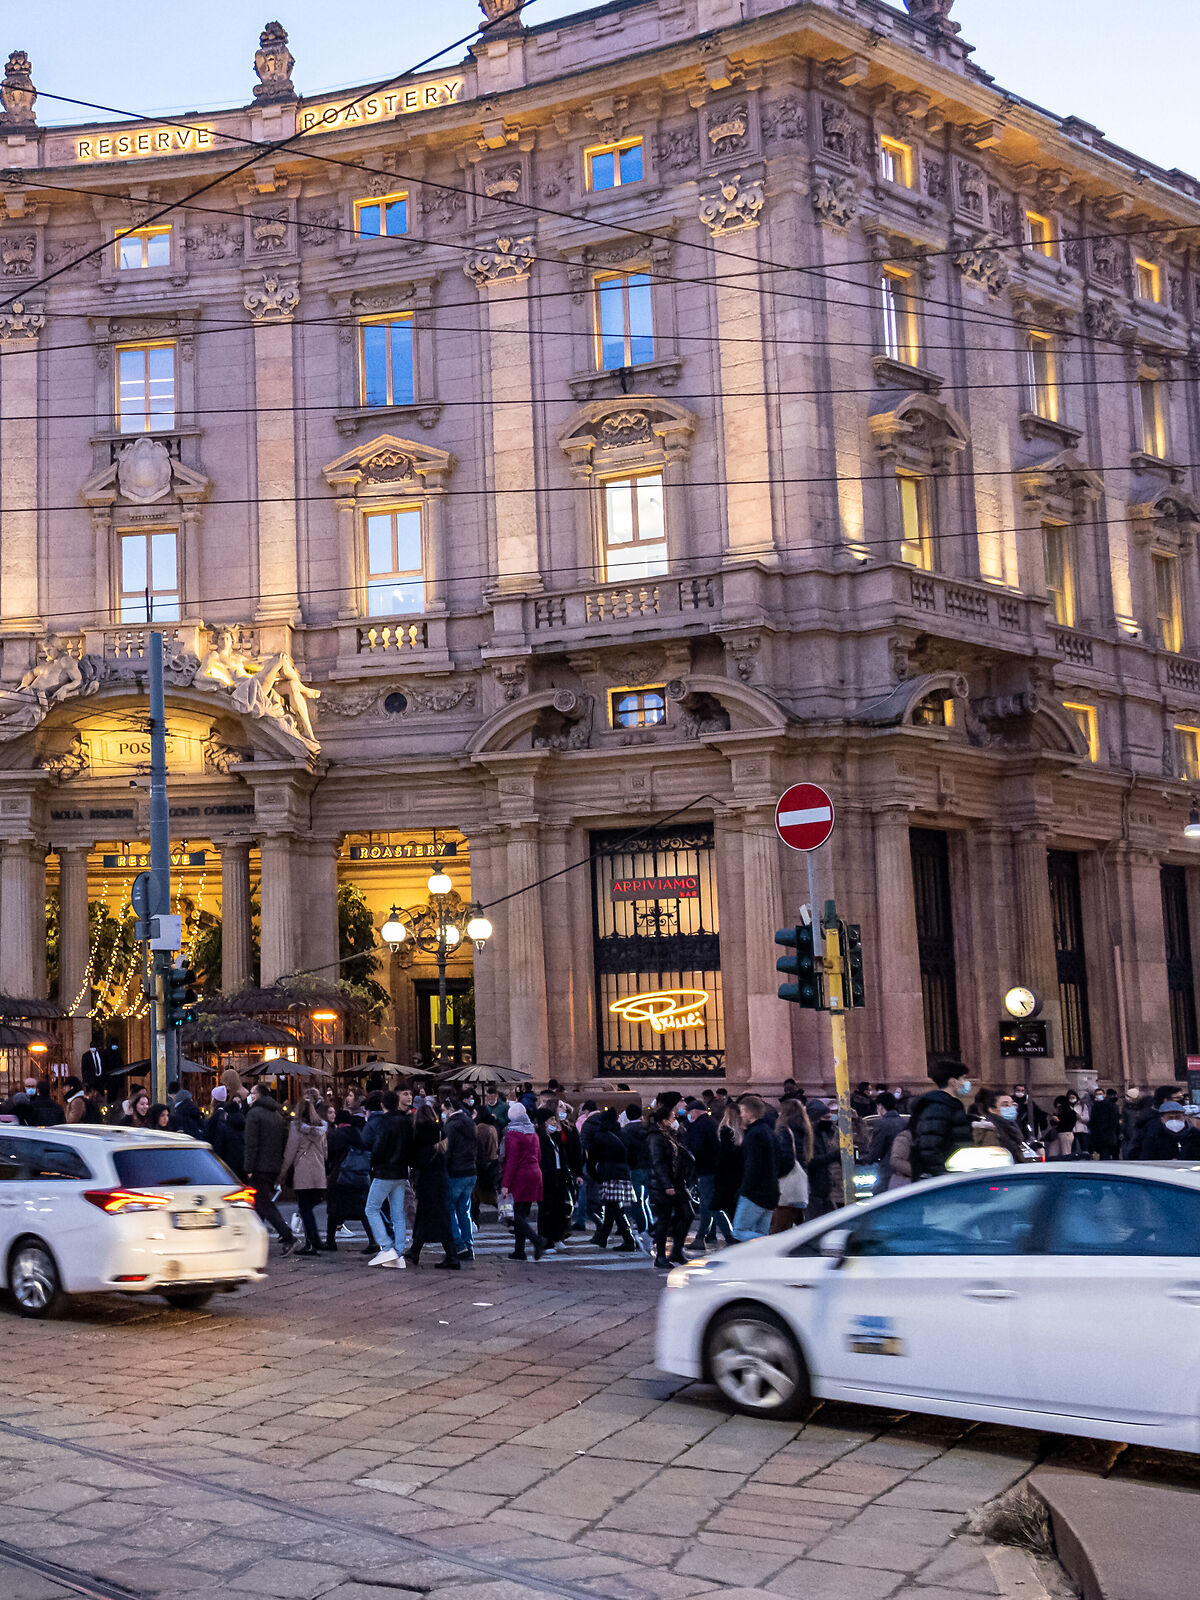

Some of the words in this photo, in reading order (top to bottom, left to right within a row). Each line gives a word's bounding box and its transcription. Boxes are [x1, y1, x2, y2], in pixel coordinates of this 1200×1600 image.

[79, 129, 209, 157] RESERVE
[304, 82, 458, 129] ROASTERY
[119, 741, 174, 755] POSE
[359, 844, 446, 859] ROASTERY
[117, 853, 191, 867] RESVE
[613, 877, 697, 892] ARRIVIAMO
[679, 890, 697, 898] BAR
